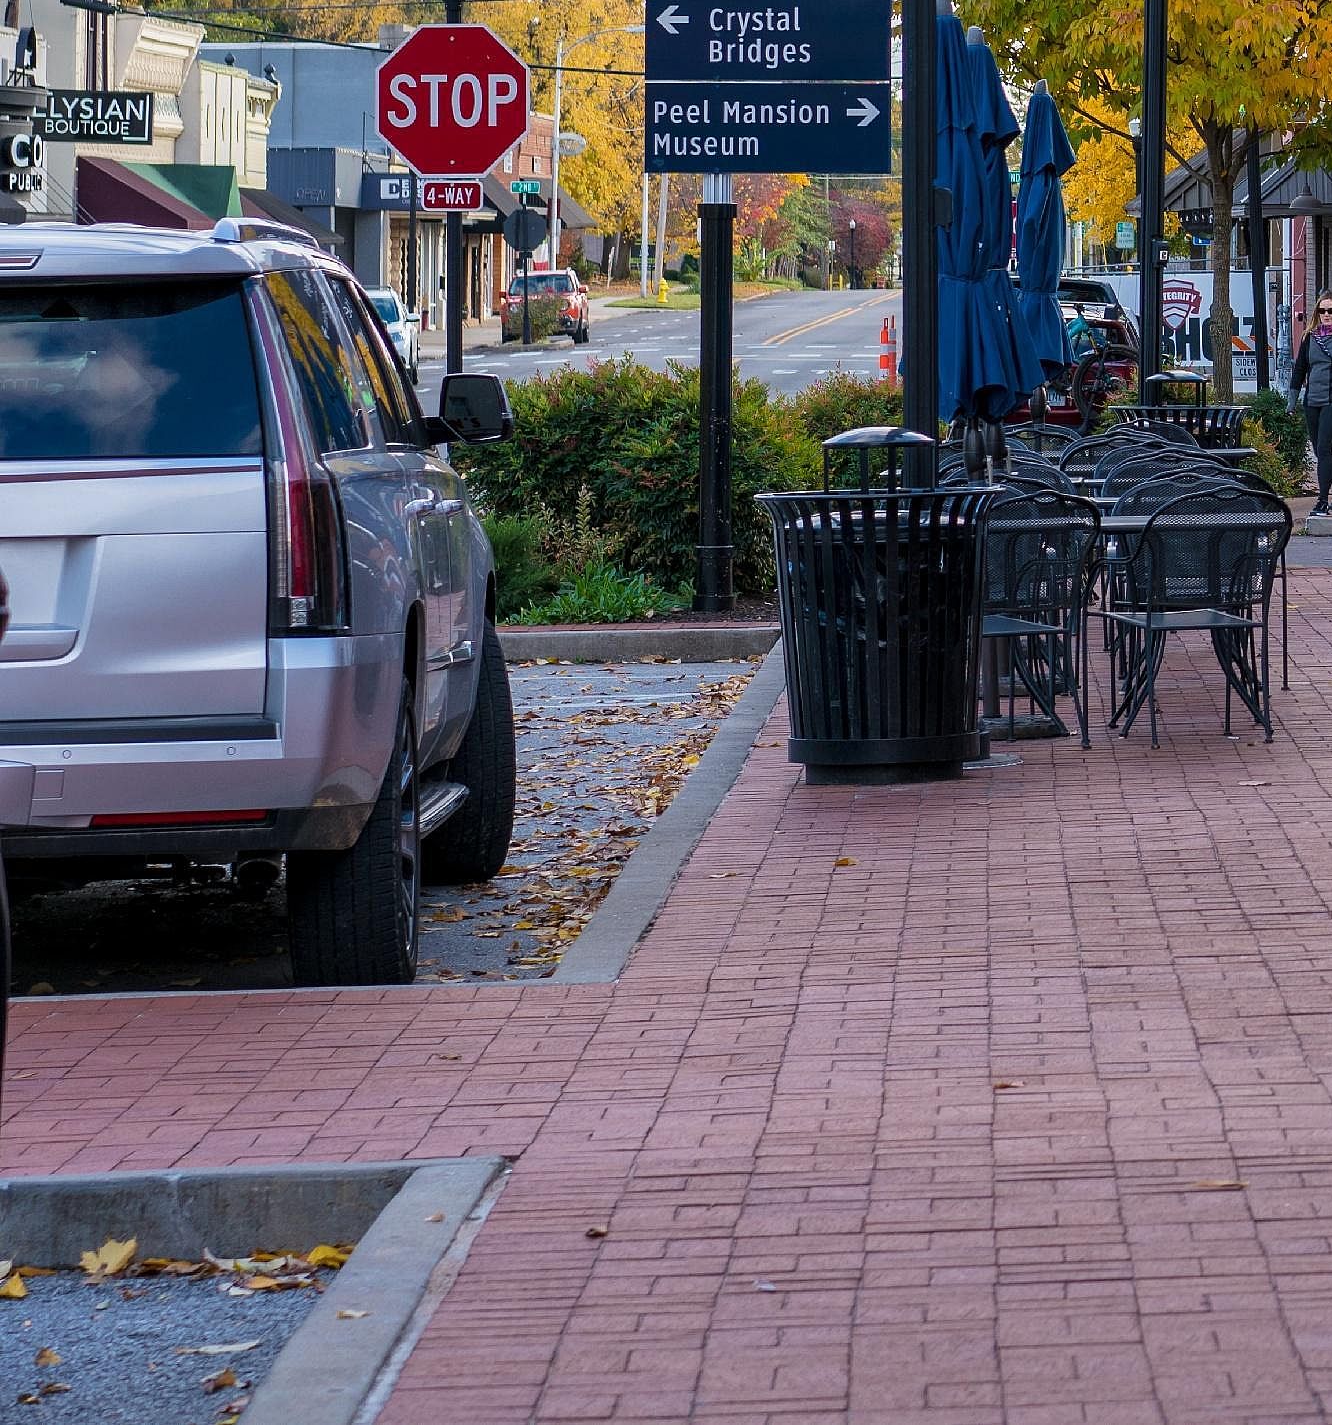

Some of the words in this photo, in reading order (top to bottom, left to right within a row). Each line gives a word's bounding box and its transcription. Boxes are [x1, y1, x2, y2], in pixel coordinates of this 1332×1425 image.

[709, 6, 801, 37] Crystal
[709, 37, 812, 69] Bridges
[387, 73, 518, 128] STOP
[653, 99, 711, 124] Peel
[723, 99, 830, 124] Mansion
[44, 119, 131, 136] BOUTIQUE
[653, 133, 759, 156] Museum
[427, 187, 474, 205] 4-WAY
